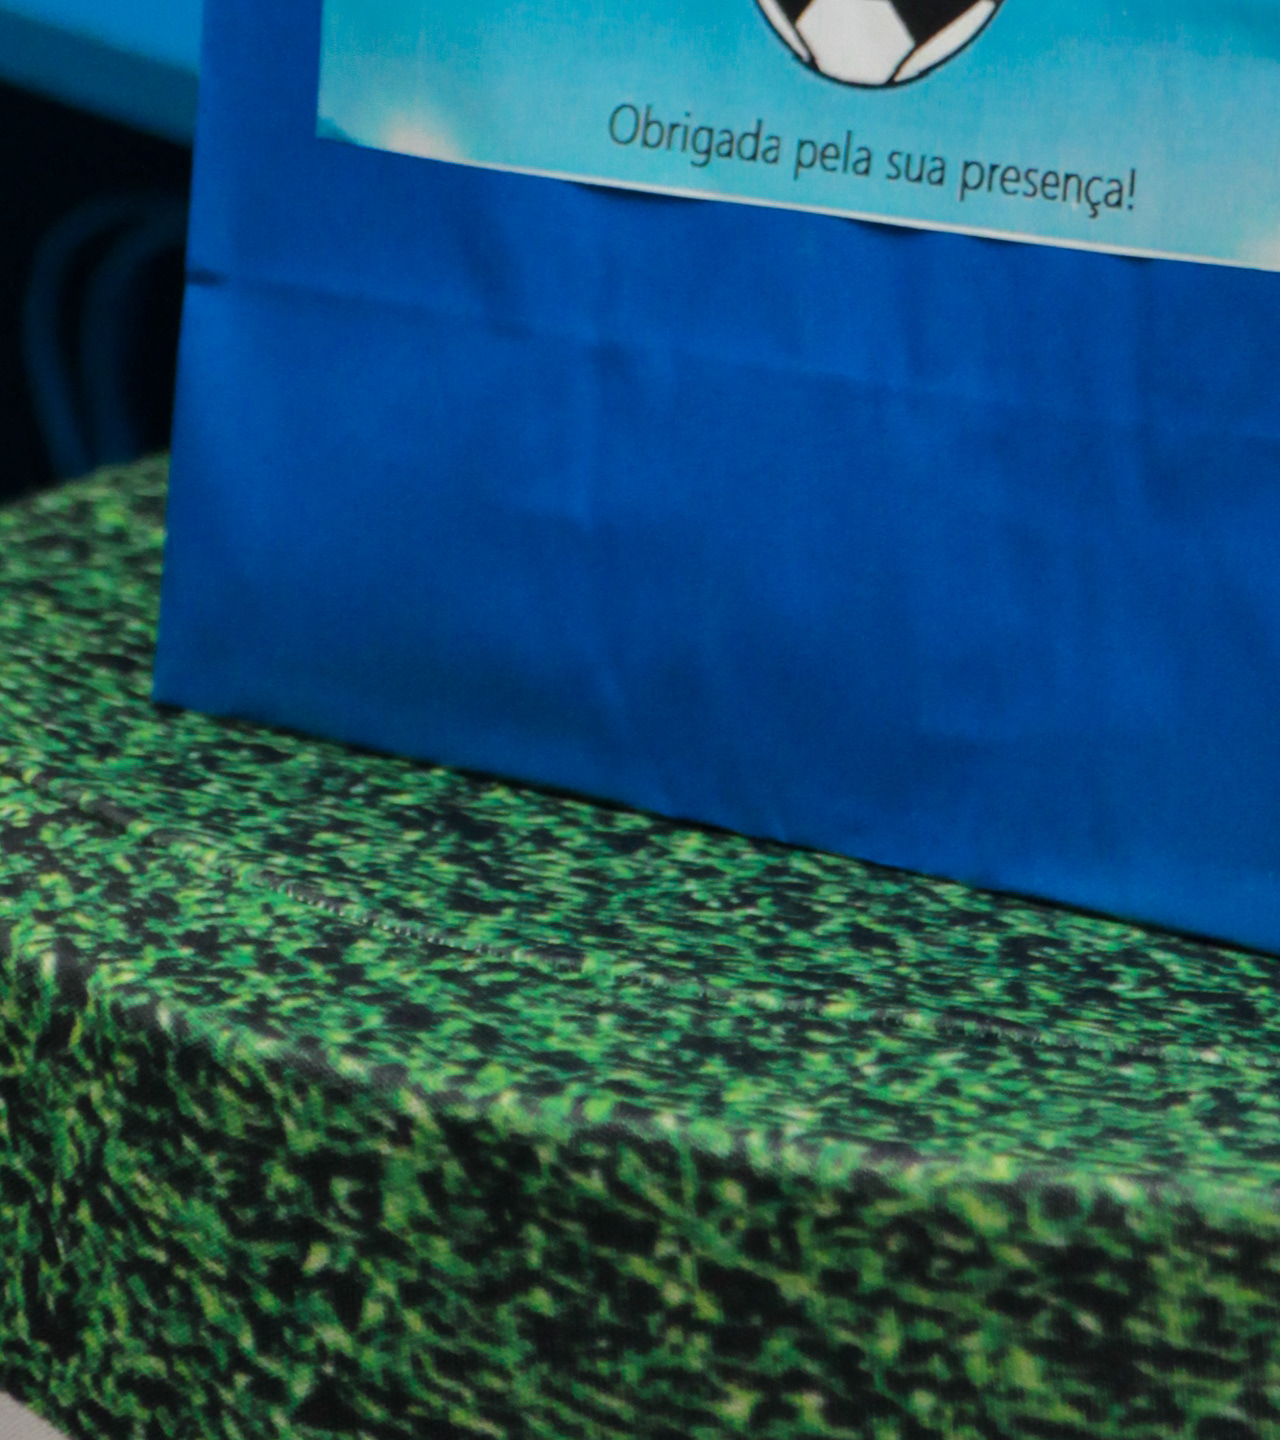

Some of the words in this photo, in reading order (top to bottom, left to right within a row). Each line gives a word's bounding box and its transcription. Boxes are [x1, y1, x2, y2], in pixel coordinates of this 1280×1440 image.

[608, 103, 781, 167] Obrigada
[793, 129, 872, 180] pela
[885, 147, 946, 186] sua
[958, 156, 1138, 219] presença!
